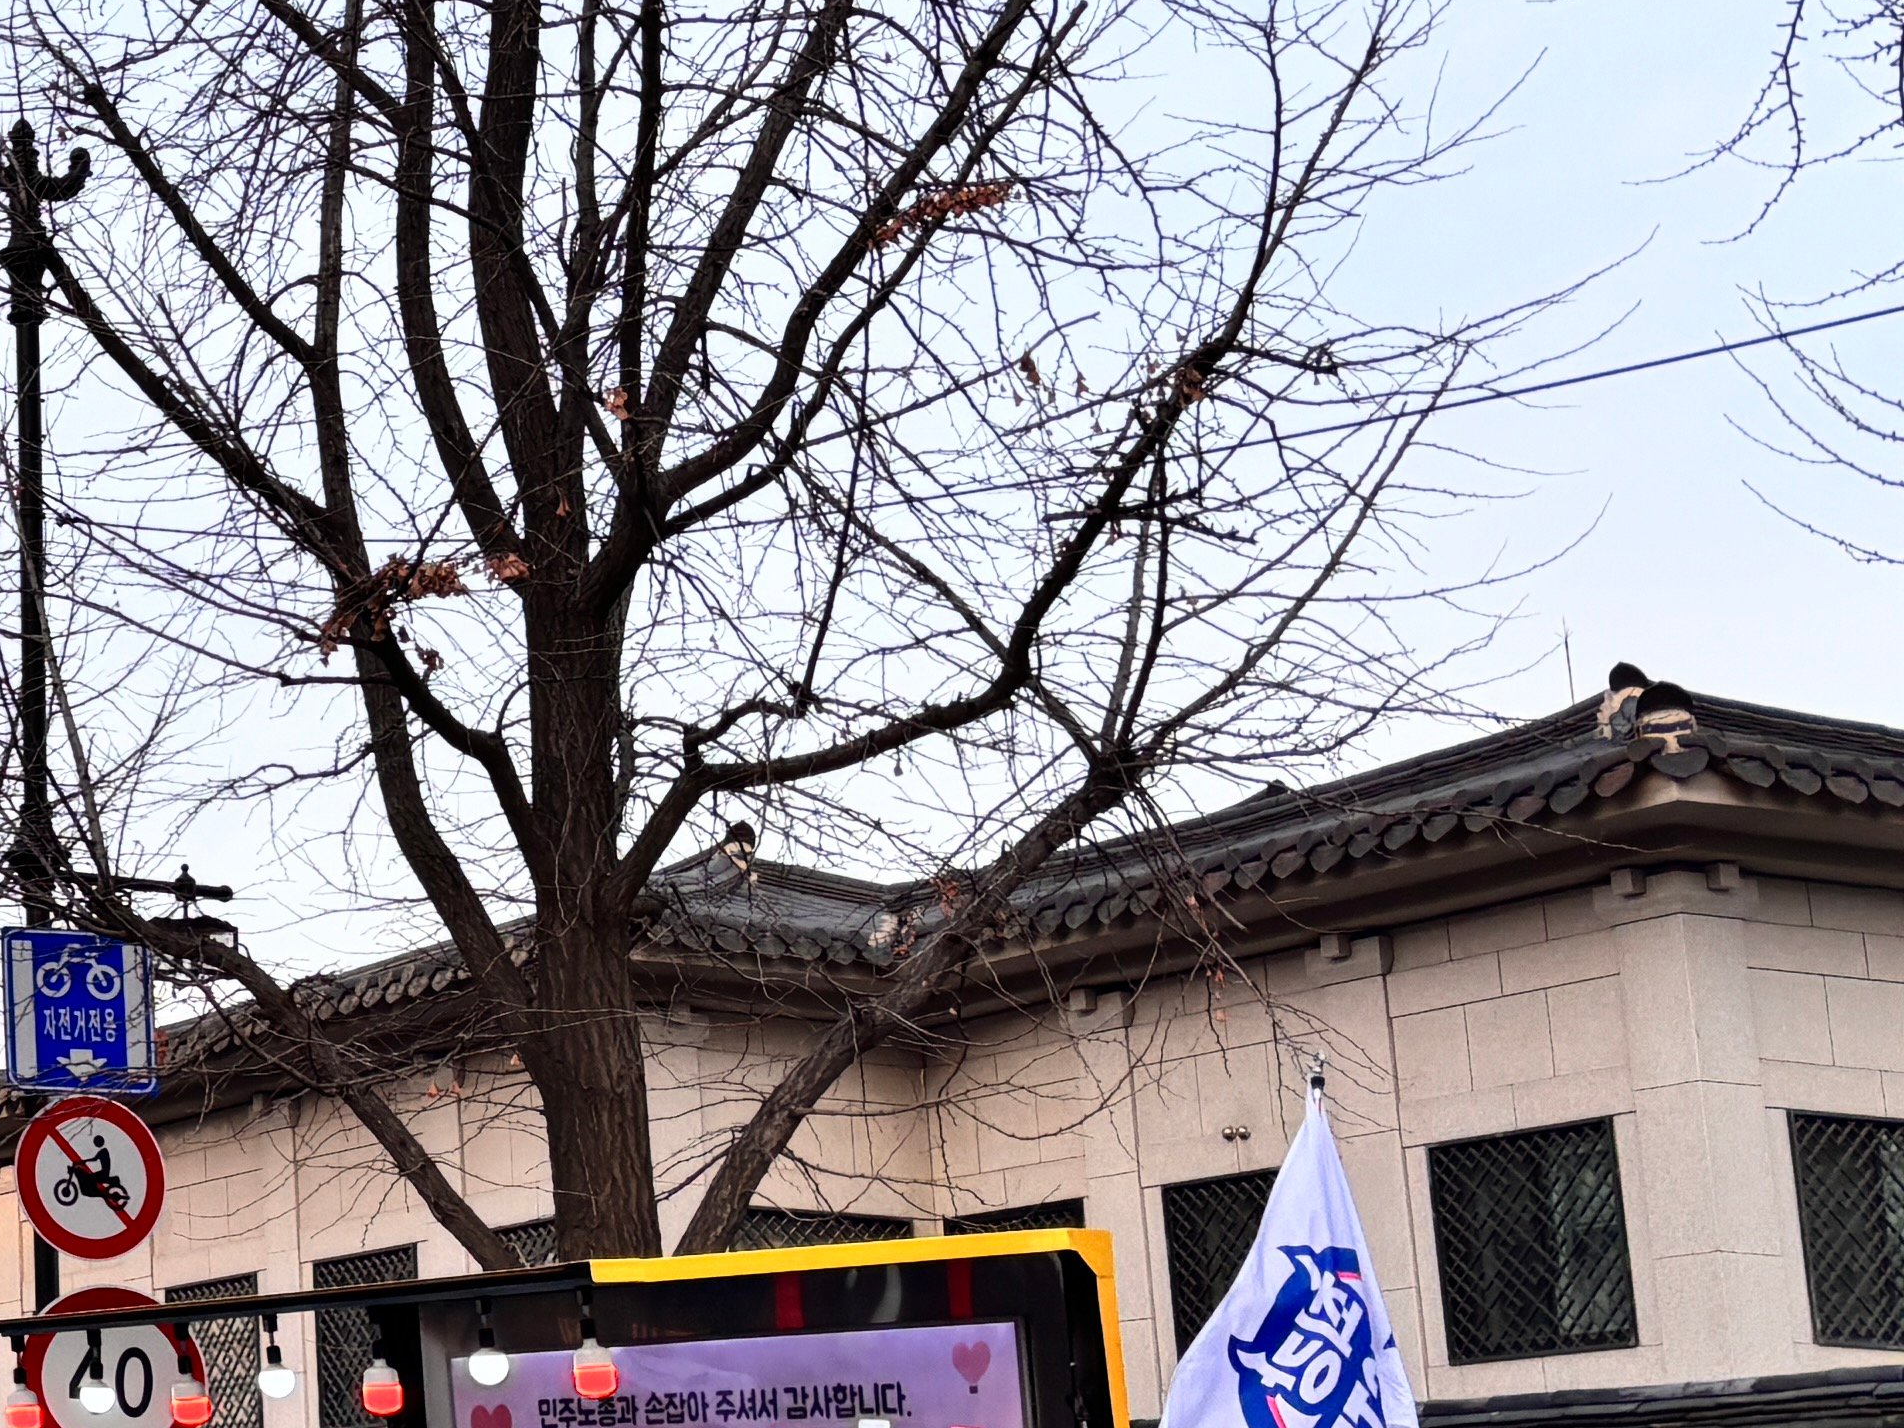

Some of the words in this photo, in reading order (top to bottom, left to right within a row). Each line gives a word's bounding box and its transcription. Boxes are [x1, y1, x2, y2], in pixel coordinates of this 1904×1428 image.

[43, 1006, 117, 1042] 자전거전용
[645, 1391, 709, 1425] 손잡아
[715, 1387, 779, 1422] 주셔서
[785, 1381, 913, 1420] 감사합니다.
